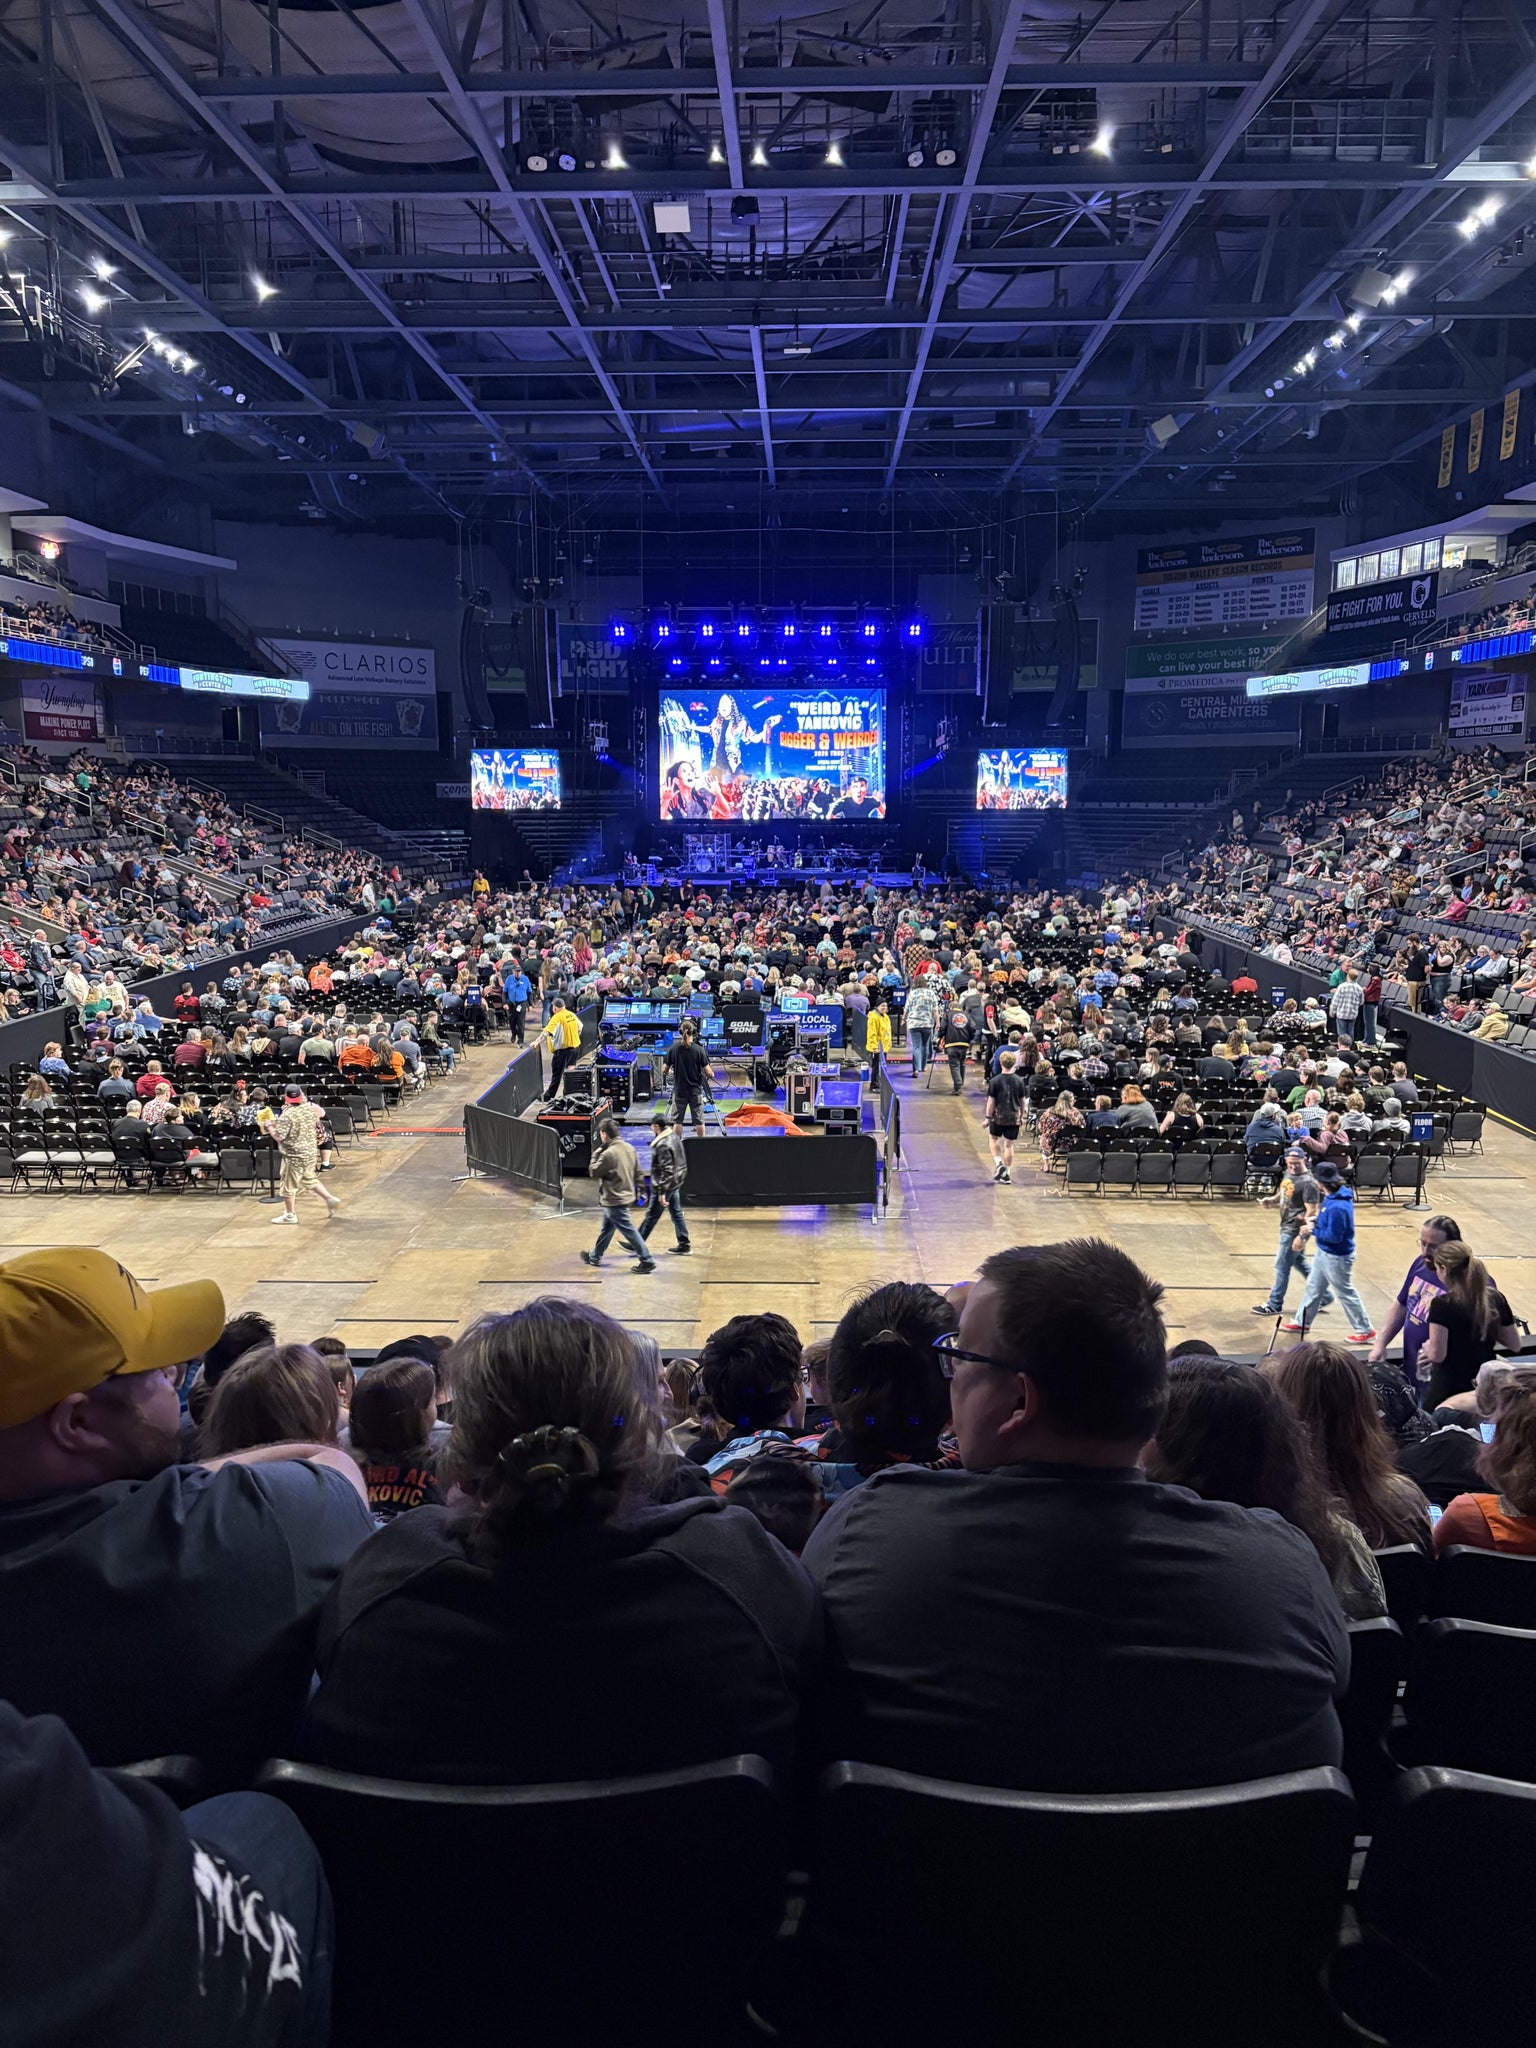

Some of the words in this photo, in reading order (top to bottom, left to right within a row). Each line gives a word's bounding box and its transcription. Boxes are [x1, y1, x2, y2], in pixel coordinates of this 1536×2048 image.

[1200, 552, 1244, 562] Andersons
[1258, 545, 1303, 556] Andersons
[1148, 558, 1188, 569] Andersons
[1328, 603, 1341, 620] WE
[1341, 599, 1366, 618] FIGHT
[1366, 595, 1384, 614] FOR
[1385, 592, 1404, 610] YOU.
[1403, 608, 1436, 622] GERVELIS
[571, 640, 621, 659] BUD
[1147, 652, 1162, 662] We
[1164, 651, 1177, 661] do
[1178, 652, 1194, 660] our
[1198, 648, 1217, 659] best
[1248, 646, 1260, 655] so
[324, 652, 427, 675] CLARIOS
[561, 660, 628, 678] LIGHT
[1159, 665, 1176, 673] can
[1178, 661, 1196, 671] live
[1198, 662, 1221, 674] your
[1223, 658, 1246, 669] best
[192, 672, 232, 688] HUNTINGTON
[1168, 677, 1224, 688] PROMEDICA
[1262, 675, 1299, 690] HUNTINGTON
[1318, 669, 1358, 684] HUNTINGTON
[252, 678, 292, 693] HUNTINGTON
[1468, 682, 1487, 697] YARK
[1181, 697, 1226, 708] CENTRAL
[1188, 705, 1268, 719] CARPENTERS
[310, 720, 326, 734] ALL
[328, 720, 337, 735] IN
[340, 722, 352, 735] ON
[353, 722, 370, 736] THE
[371, 722, 393, 736] FISH!
[796, 716, 862, 730] YANKOVIC
[780, 732, 816, 750] BIGGER
[819, 733, 830, 750] &
[802, 1015, 831, 1024] LOCAL
